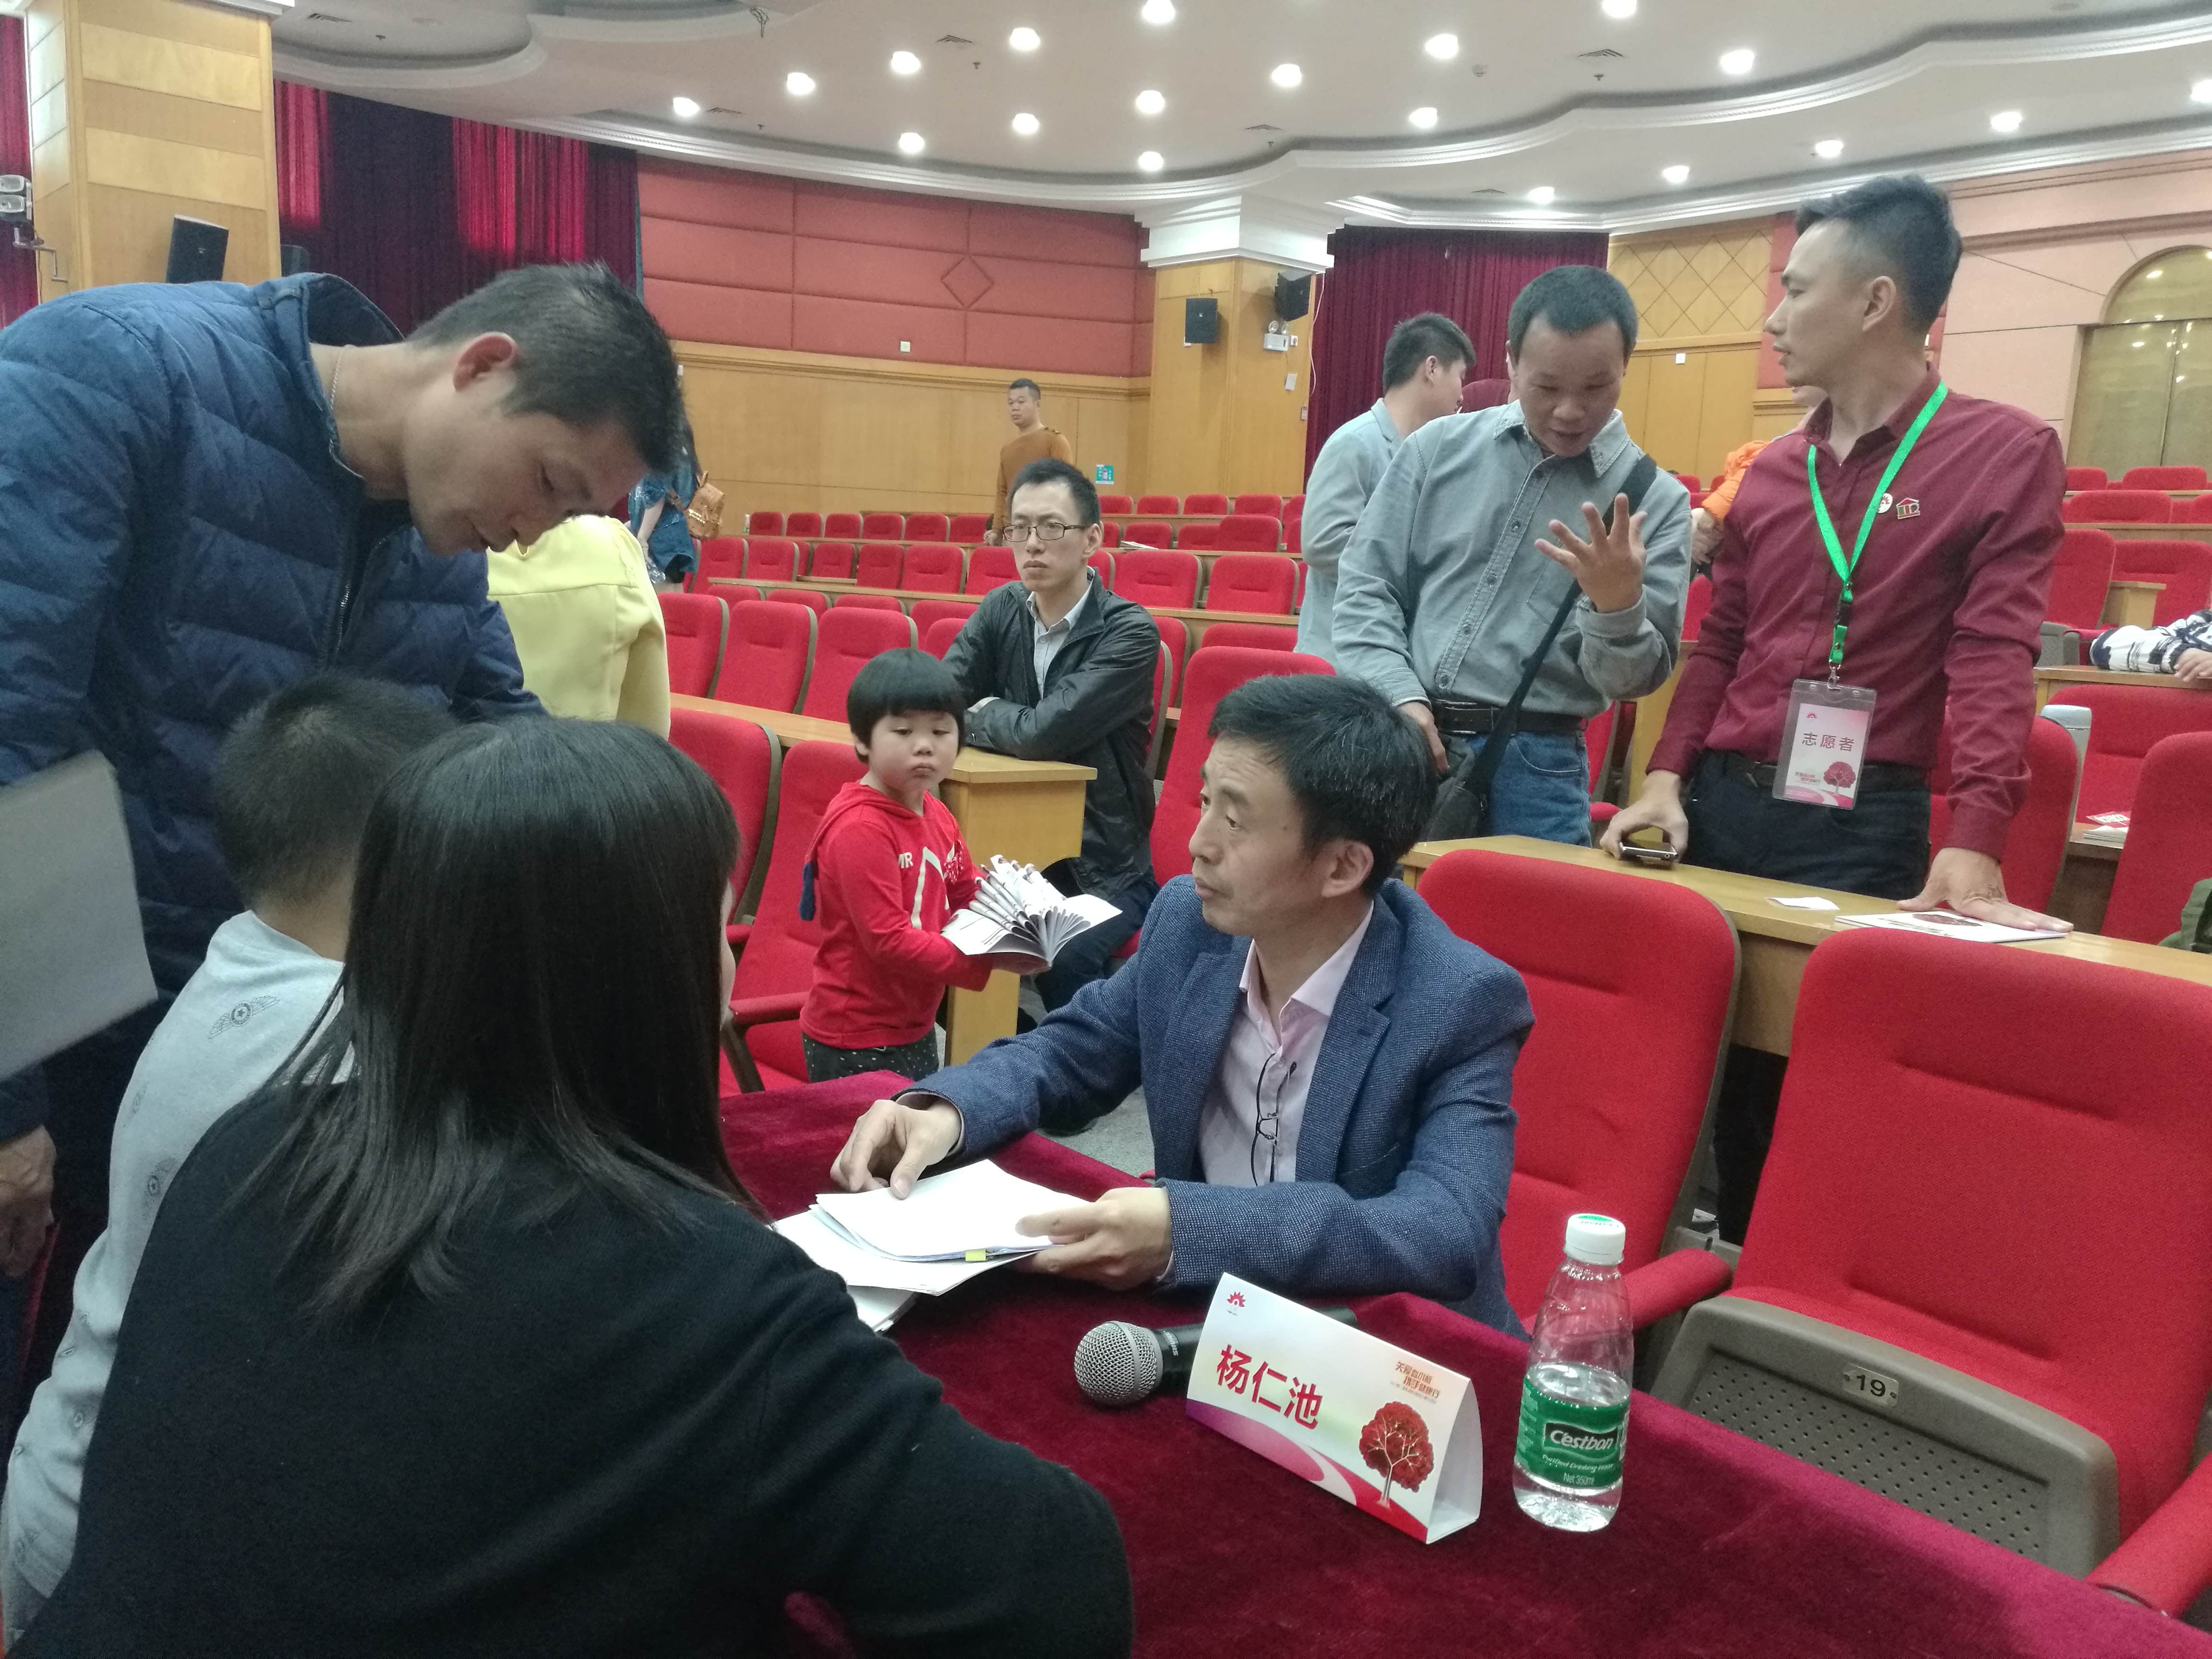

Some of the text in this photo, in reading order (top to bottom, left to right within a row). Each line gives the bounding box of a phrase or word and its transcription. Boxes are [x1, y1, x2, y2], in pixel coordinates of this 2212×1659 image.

[1802, 732, 1855, 752] 志愿者
[1216, 1344, 1323, 1430] 杨仁池
[1856, 1374, 1886, 1397] 19
[1542, 1454, 1570, 1467] Purified
[1570, 1463, 1597, 1473] Drinking
[1563, 1472, 1575, 1483] Net
